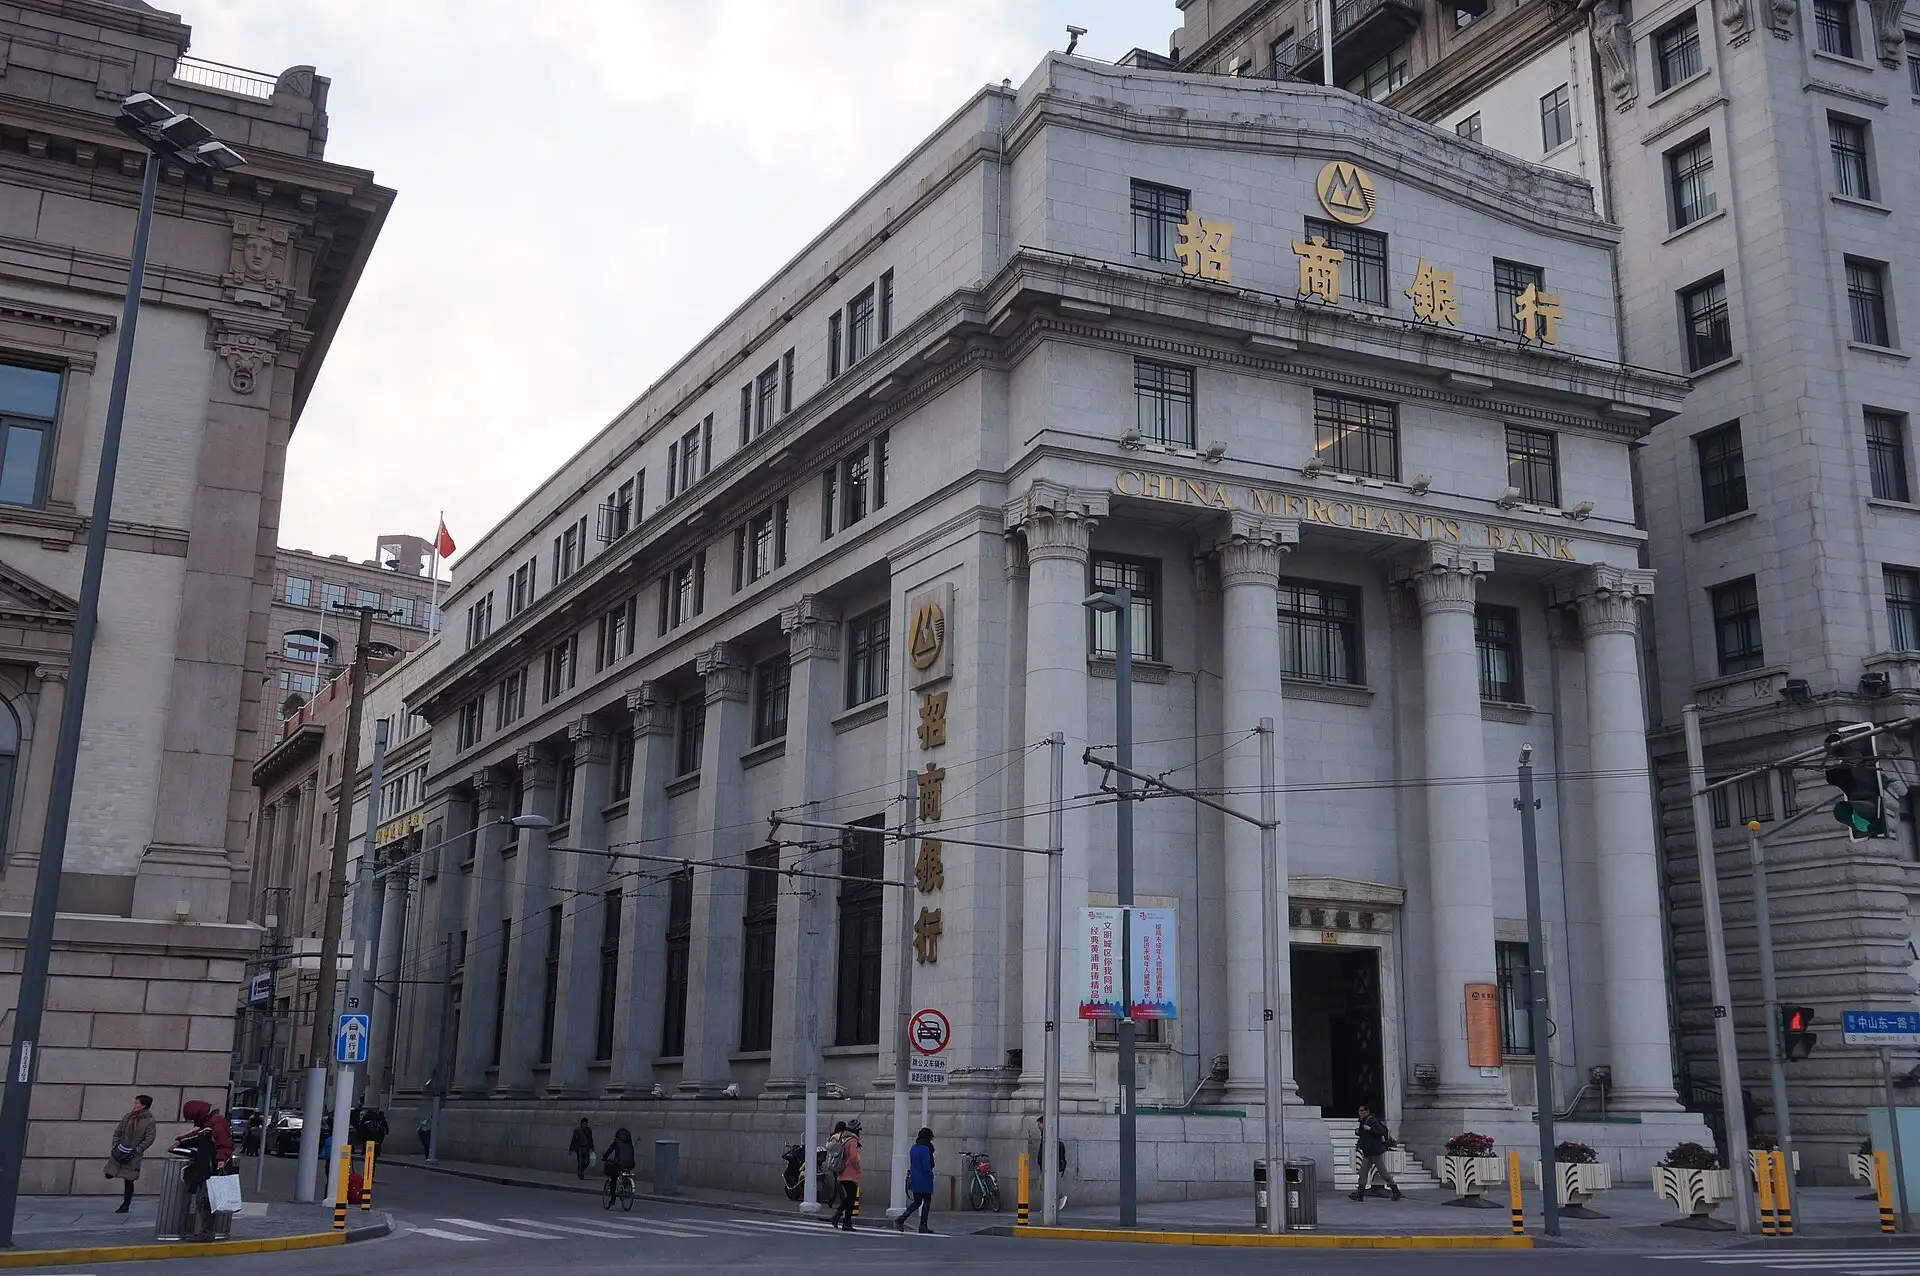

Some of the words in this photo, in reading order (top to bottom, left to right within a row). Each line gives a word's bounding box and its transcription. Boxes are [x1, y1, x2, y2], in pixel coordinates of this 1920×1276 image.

[1174, 210, 1563, 344] 招商銀行
[1115, 470, 1232, 508] CHINA
[1251, 488, 1461, 541] MERCHANTS
[1485, 525, 1576, 561] BANK
[914, 690, 948, 964] 招商銀行
[347, 1033, 357, 1059] 单行道
[1857, 1015, 1908, 1030] 中山东一路
